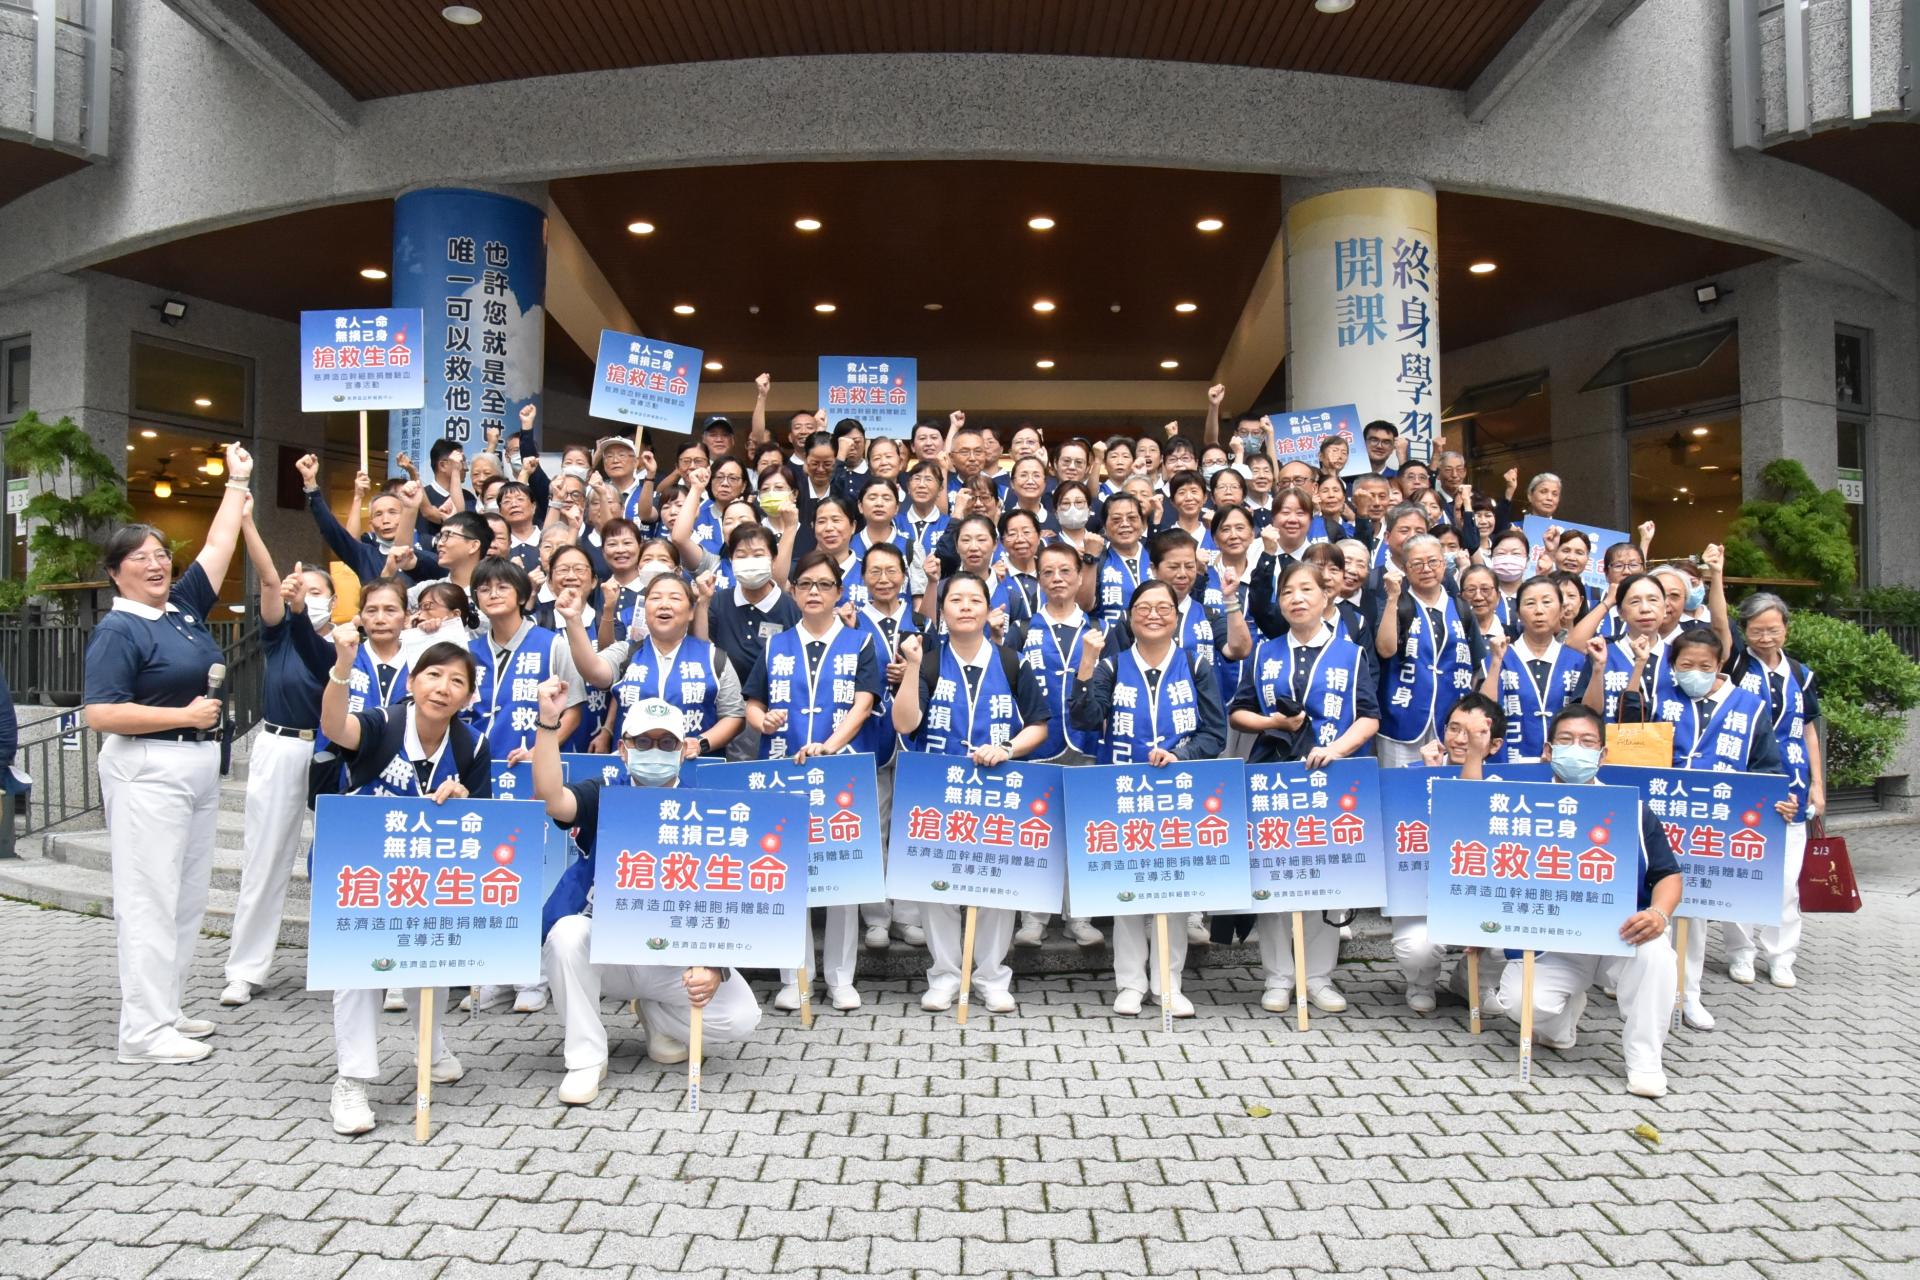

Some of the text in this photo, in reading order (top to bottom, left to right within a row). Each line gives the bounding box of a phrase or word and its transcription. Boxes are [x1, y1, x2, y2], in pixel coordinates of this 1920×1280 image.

[1334, 236, 1388, 348] 開課
[335, 315, 388, 329] 救人一命
[335, 329, 388, 343] 無損己身
[444, 236, 476, 442] 唯一可以救他的
[312, 344, 411, 369] 搶救生命
[630, 342, 675, 360] 救人一命
[1392, 237, 1432, 464] 終身學習
[628, 354, 673, 372] 無損己身
[847, 362, 889, 373] 救人一命
[605, 363, 688, 396] 搶救生命
[828, 385, 907, 406] 搶救生命
[1289, 412, 1331, 426] 救人一命
[1102, 565, 1124, 624] 無損己
[748, 767, 825, 790] 救人一命
[946, 766, 1024, 789] 救人一命
[1115, 771, 1193, 793] 救人一命
[1250, 770, 1328, 791] 救人一命
[944, 786, 1022, 810] 無損己身
[1649, 778, 1733, 800] 救人一命
[659, 800, 751, 823] 救人一命
[1117, 793, 1194, 814] 無損己身
[1252, 791, 1329, 812] 無損己身
[1489, 793, 1579, 816] 救人一命
[1648, 798, 1731, 821] 無損己身
[384, 810, 483, 834] 救人一命
[908, 805, 1052, 850] 搶救生命
[1247, 812, 1365, 852] 救生命
[1488, 816, 1578, 839] 無損己身
[657, 823, 749, 848] 無損己身
[1085, 814, 1229, 854] 搶救生命
[383, 836, 482, 860] 無損己身
[808, 848, 863, 864] 捐贈驗血
[906, 846, 1048, 869] 慈濟造血幹細胞捐贈驗血
[615, 850, 788, 894] 搶救生命
[951, 863, 1002, 878] 宣導活動
[1087, 854, 1231, 872] 慈濟造血幹細胞捐贈驗血
[1449, 839, 1617, 884] 搶救生命
[1134, 869, 1185, 883] 宣導活動
[1269, 868, 1321, 881] 宣導活動
[336, 865, 522, 909] 搶救生命
[1449, 883, 1615, 905] 慈濟造血幹細胞捐贈驗血
[615, 897, 785, 916] 慈濟造血幹細胞捐贈驗血
[1501, 901, 1561, 917] 宣導活動
[1680, 897, 1733, 908] 血幹細胞中心
[336, 915, 519, 931] 慈濟造血幹細胞捐贈驗血
[669, 915, 731, 930] 宣導活動
[397, 933, 462, 948] 宣導活動
